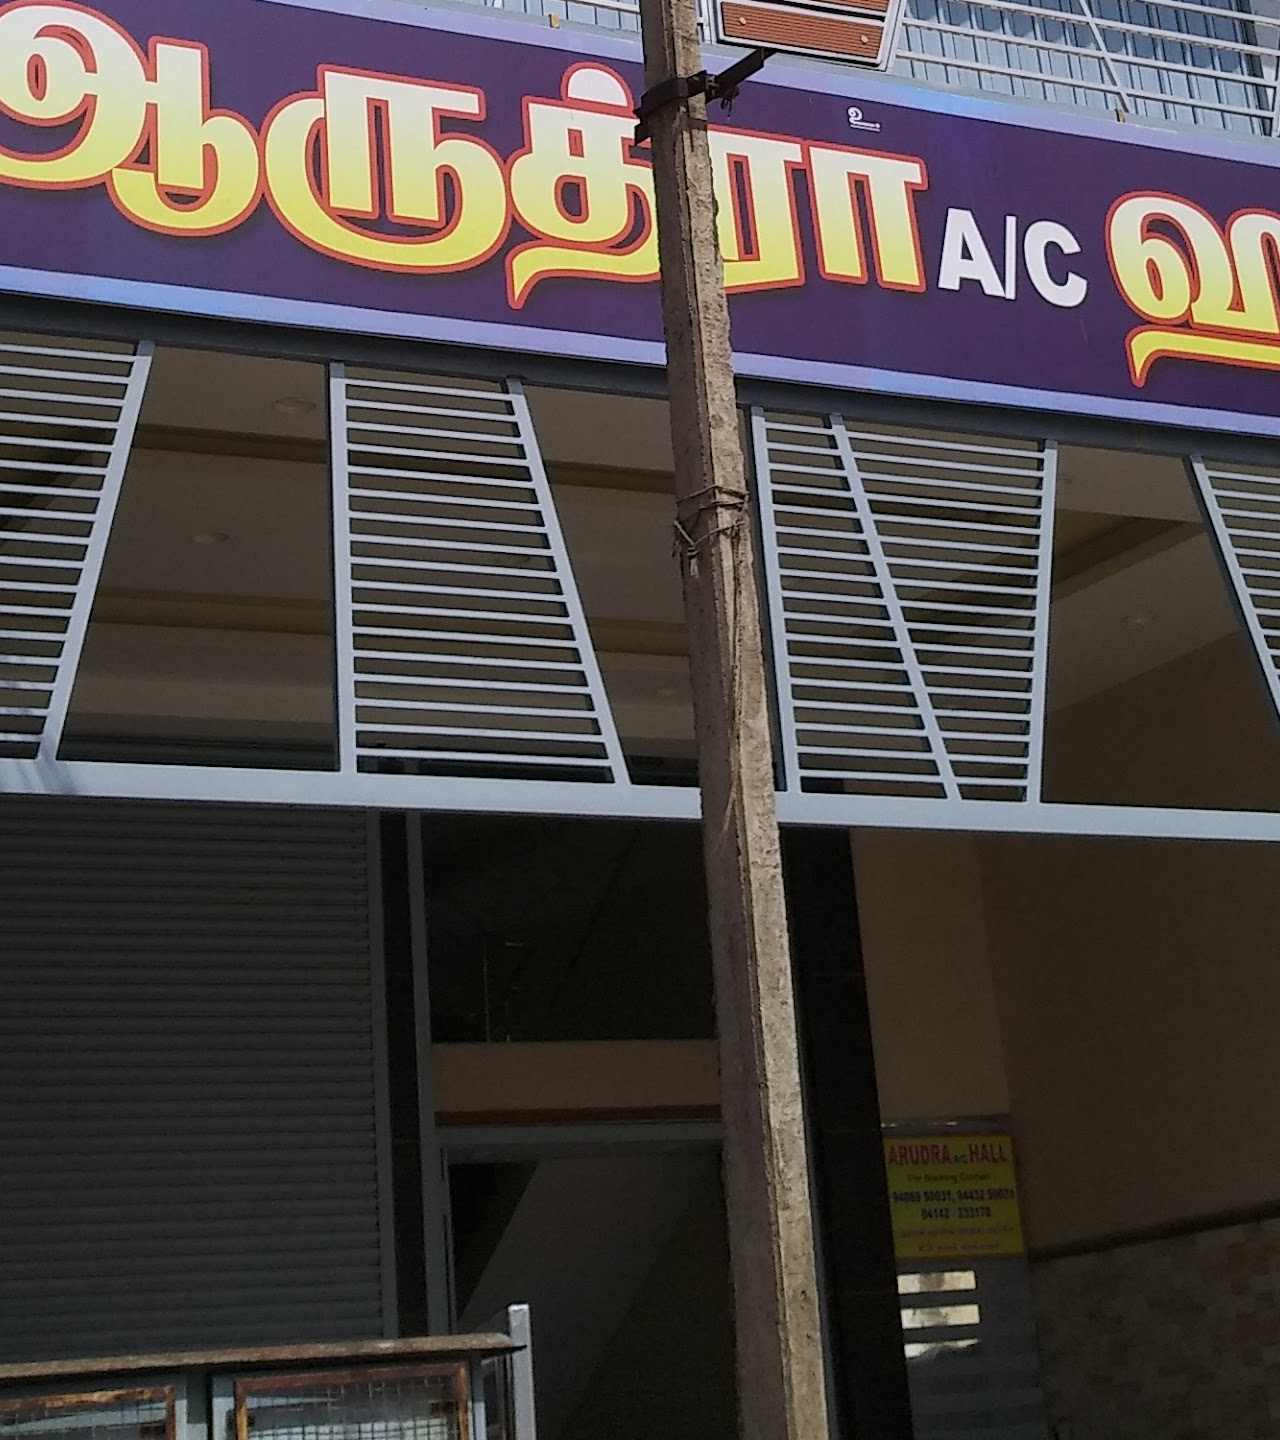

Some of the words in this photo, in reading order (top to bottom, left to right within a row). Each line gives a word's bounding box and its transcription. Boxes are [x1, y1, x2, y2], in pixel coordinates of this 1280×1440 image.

[937, 205, 1089, 310] A/C
[889, 1145, 951, 1165] ARUDRA
[969, 1143, 1008, 1163] HALL
